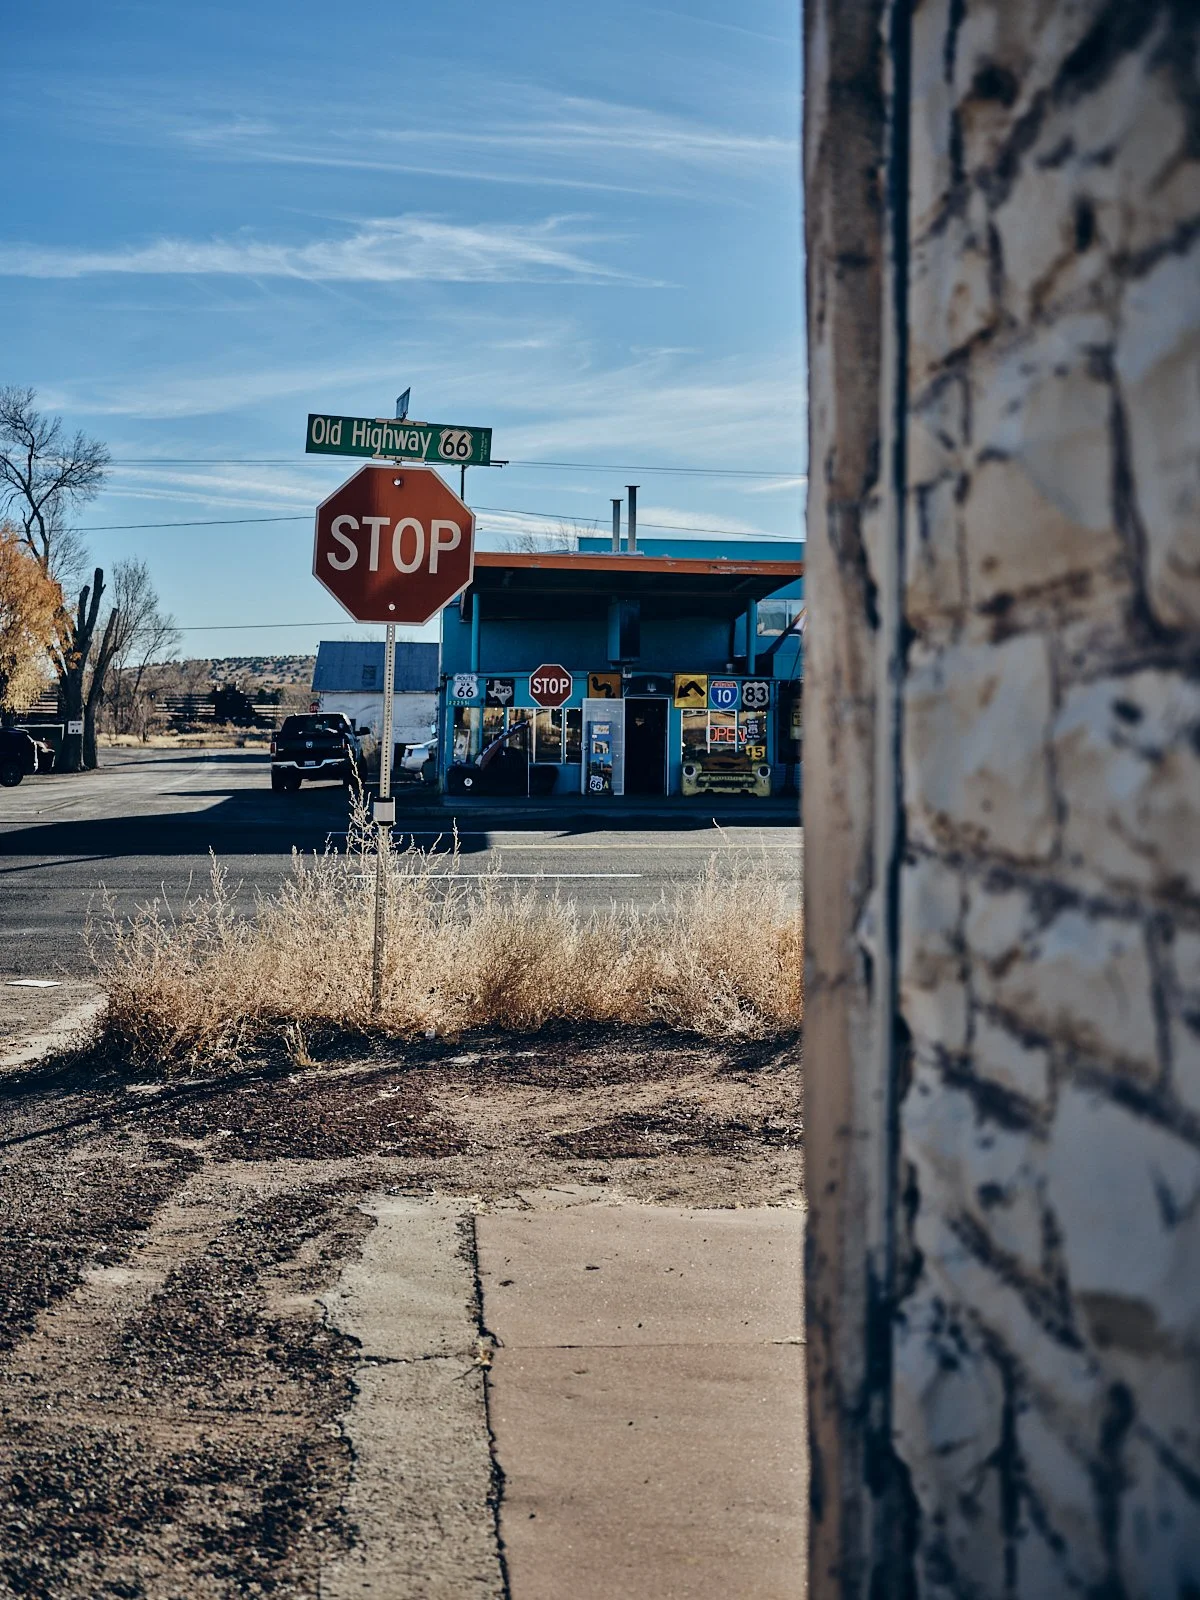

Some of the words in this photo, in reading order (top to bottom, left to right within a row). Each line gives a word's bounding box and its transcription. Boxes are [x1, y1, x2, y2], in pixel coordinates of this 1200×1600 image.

[311, 416, 342, 446] Old
[351, 421, 432, 459] Highway
[442, 433, 469, 457] 66
[327, 514, 461, 575] STOP
[457, 686, 474, 698] 66
[532, 677, 569, 694] STOP
[717, 689, 732, 703] 10
[745, 686, 767, 703] 83
[709, 727, 746, 743] OPEN
[748, 747, 763, 758] 15
[590, 780, 602, 790] 66
